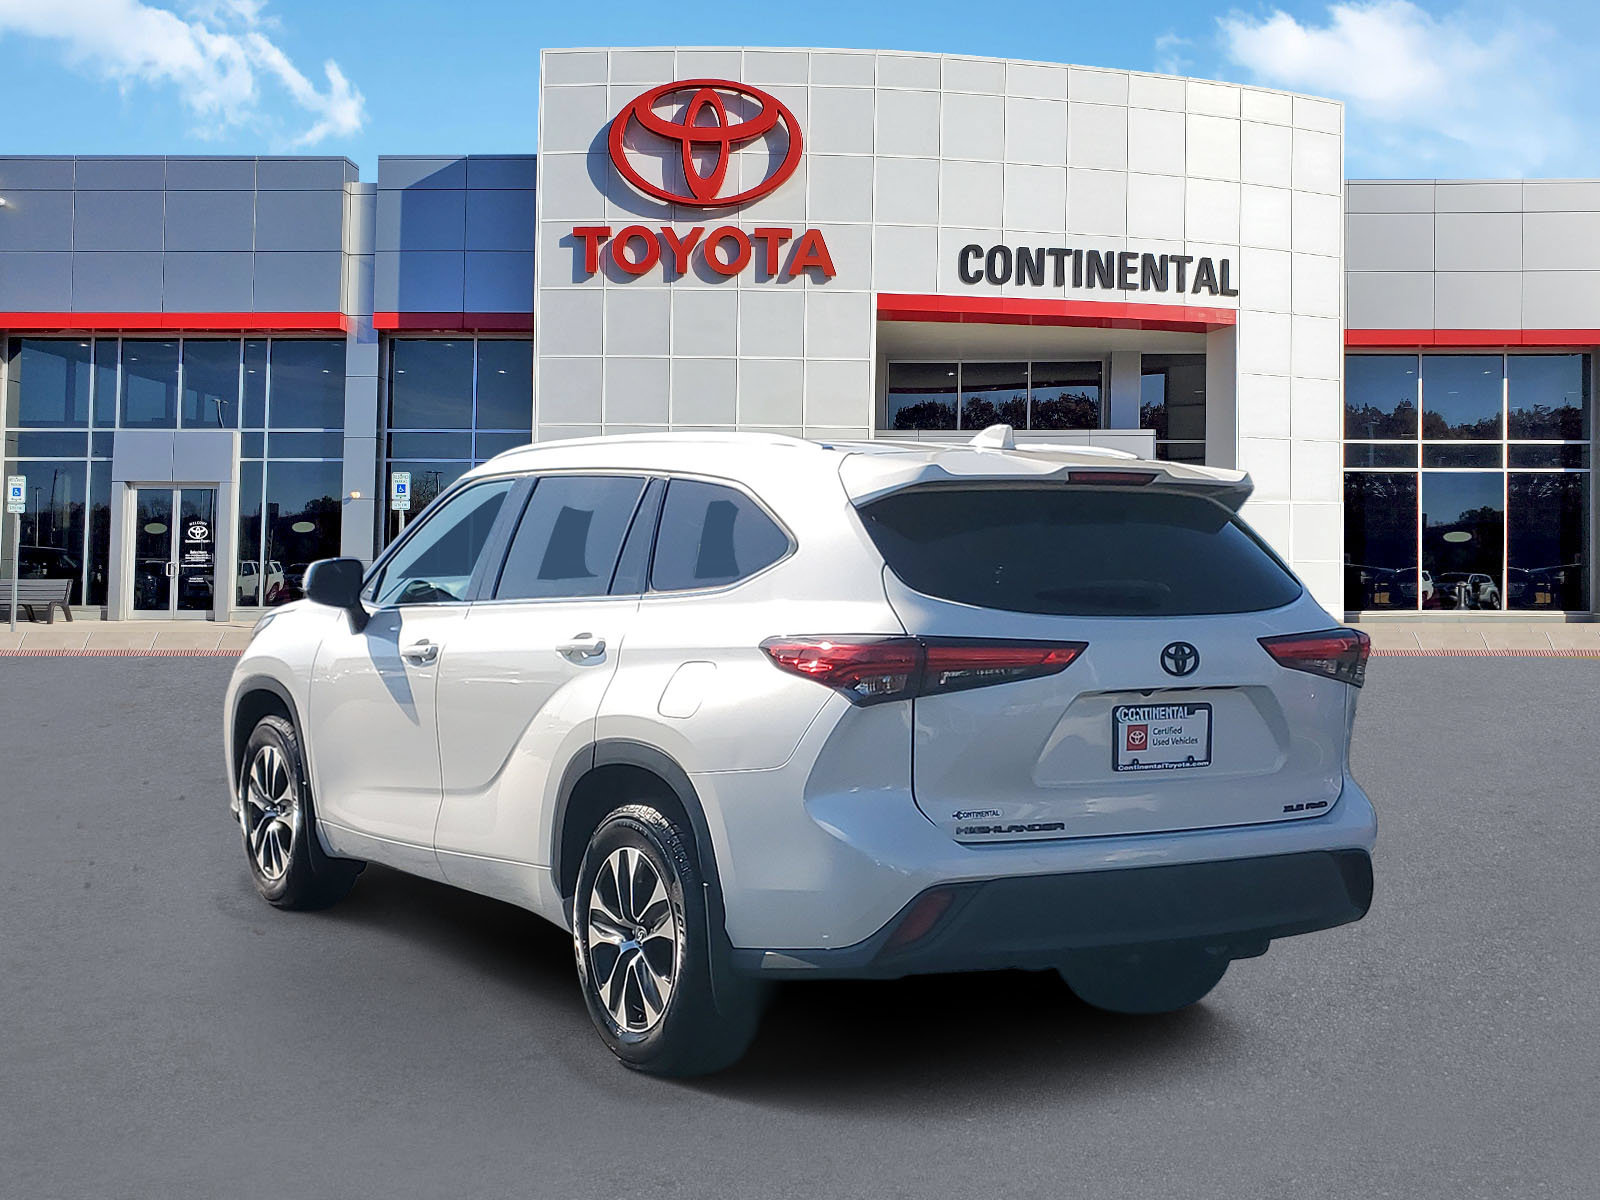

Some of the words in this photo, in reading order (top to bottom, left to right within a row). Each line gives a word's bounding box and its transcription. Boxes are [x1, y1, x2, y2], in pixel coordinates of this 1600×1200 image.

[573, 225, 836, 276] TOYOTA
[958, 244, 1239, 297] CONTINENTAL
[1117, 706, 1188, 722] CONTINENTAL
[1152, 726, 1183, 736] Certified
[1152, 738, 1170, 747] Used
[1171, 736, 1199, 746] Vehicles
[1117, 760, 1210, 772] ContinentalToyota.com
[956, 822, 1065, 835] HIGHLANDER
